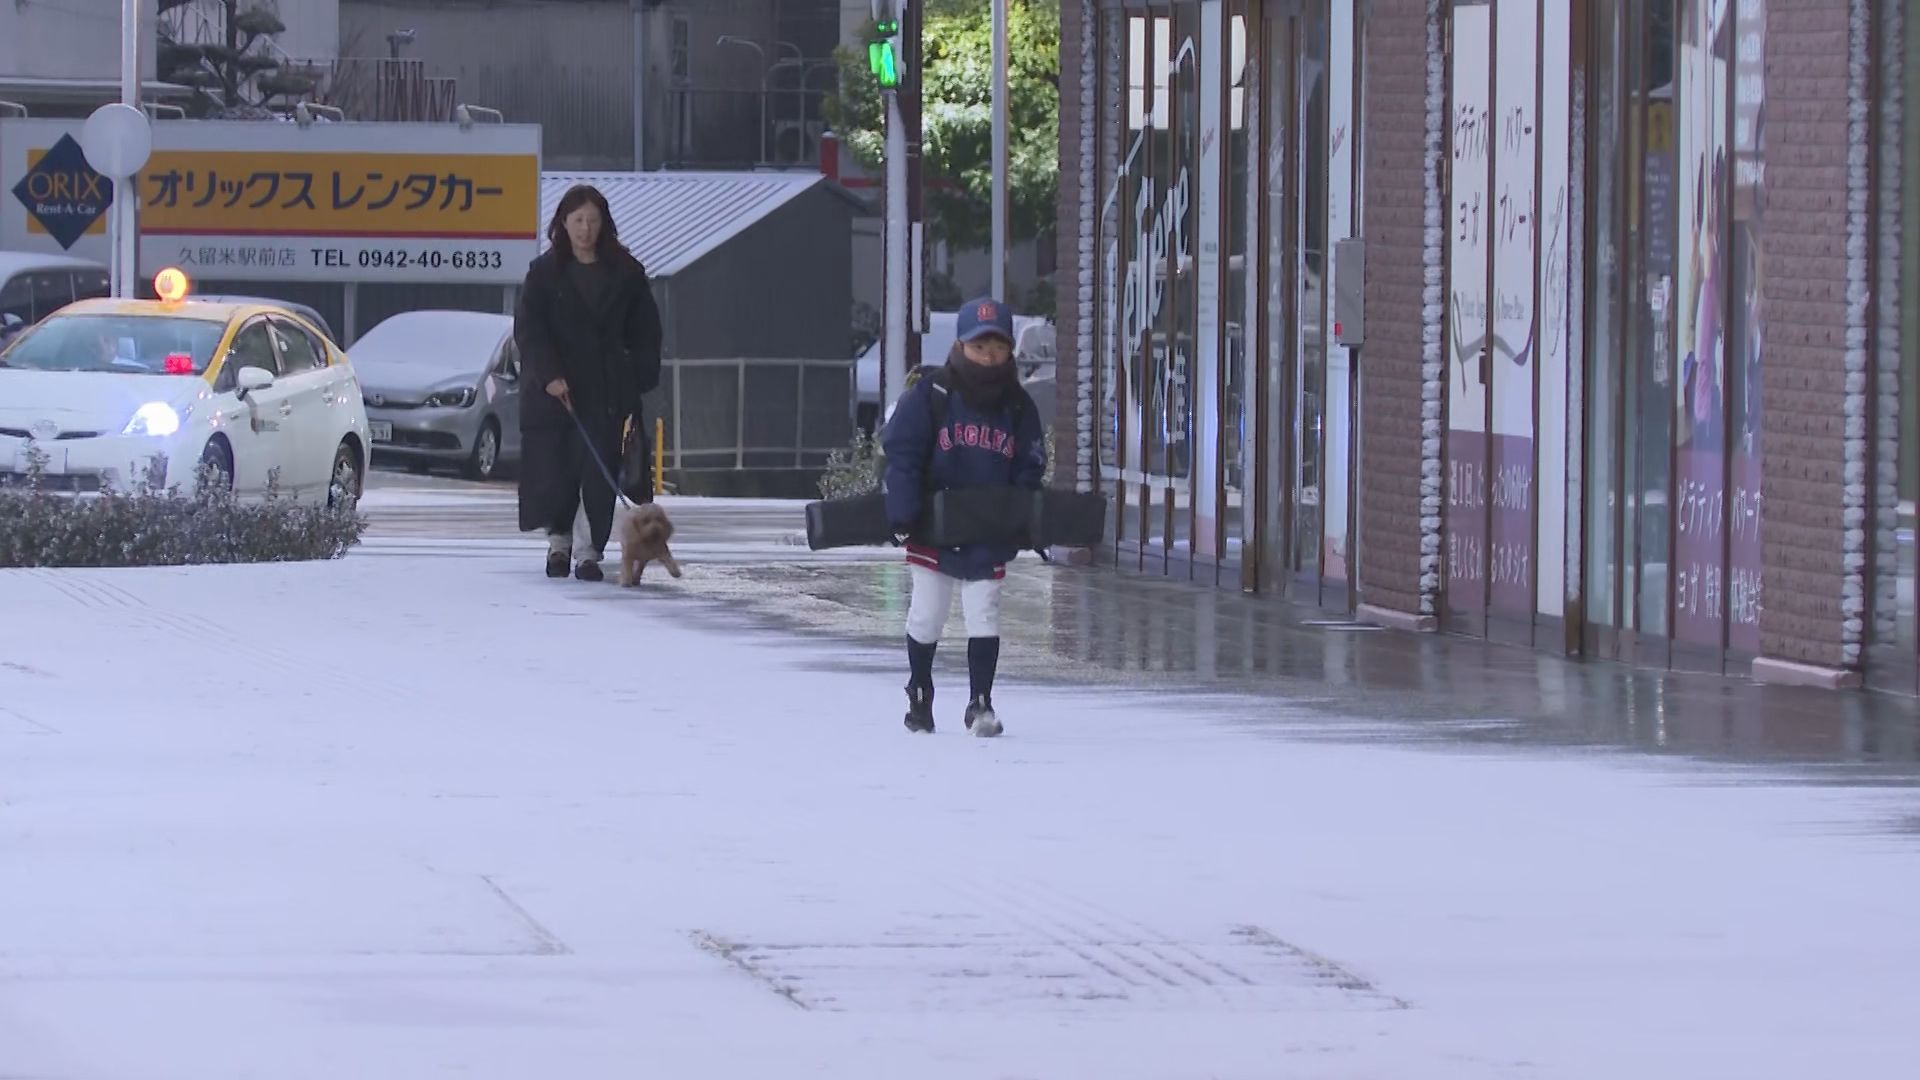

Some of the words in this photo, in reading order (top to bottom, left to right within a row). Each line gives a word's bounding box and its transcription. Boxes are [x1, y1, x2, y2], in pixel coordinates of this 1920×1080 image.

[1454, 103, 1488, 162] ピラティス
[1504, 106, 1533, 159] パワー
[27, 171, 102, 200] ORIX
[148, 170, 316, 210] オリックス
[332, 172, 503, 212] レンタカー
[1459, 191, 1481, 247] ヨガ
[178, 247, 297, 267] 久留米駅前店
[311, 249, 350, 267] TEL
[358, 249, 502, 269] 0942-40-6833
[1678, 476, 1723, 541] ピラティス
[1678, 561, 1700, 617] ヨガ
